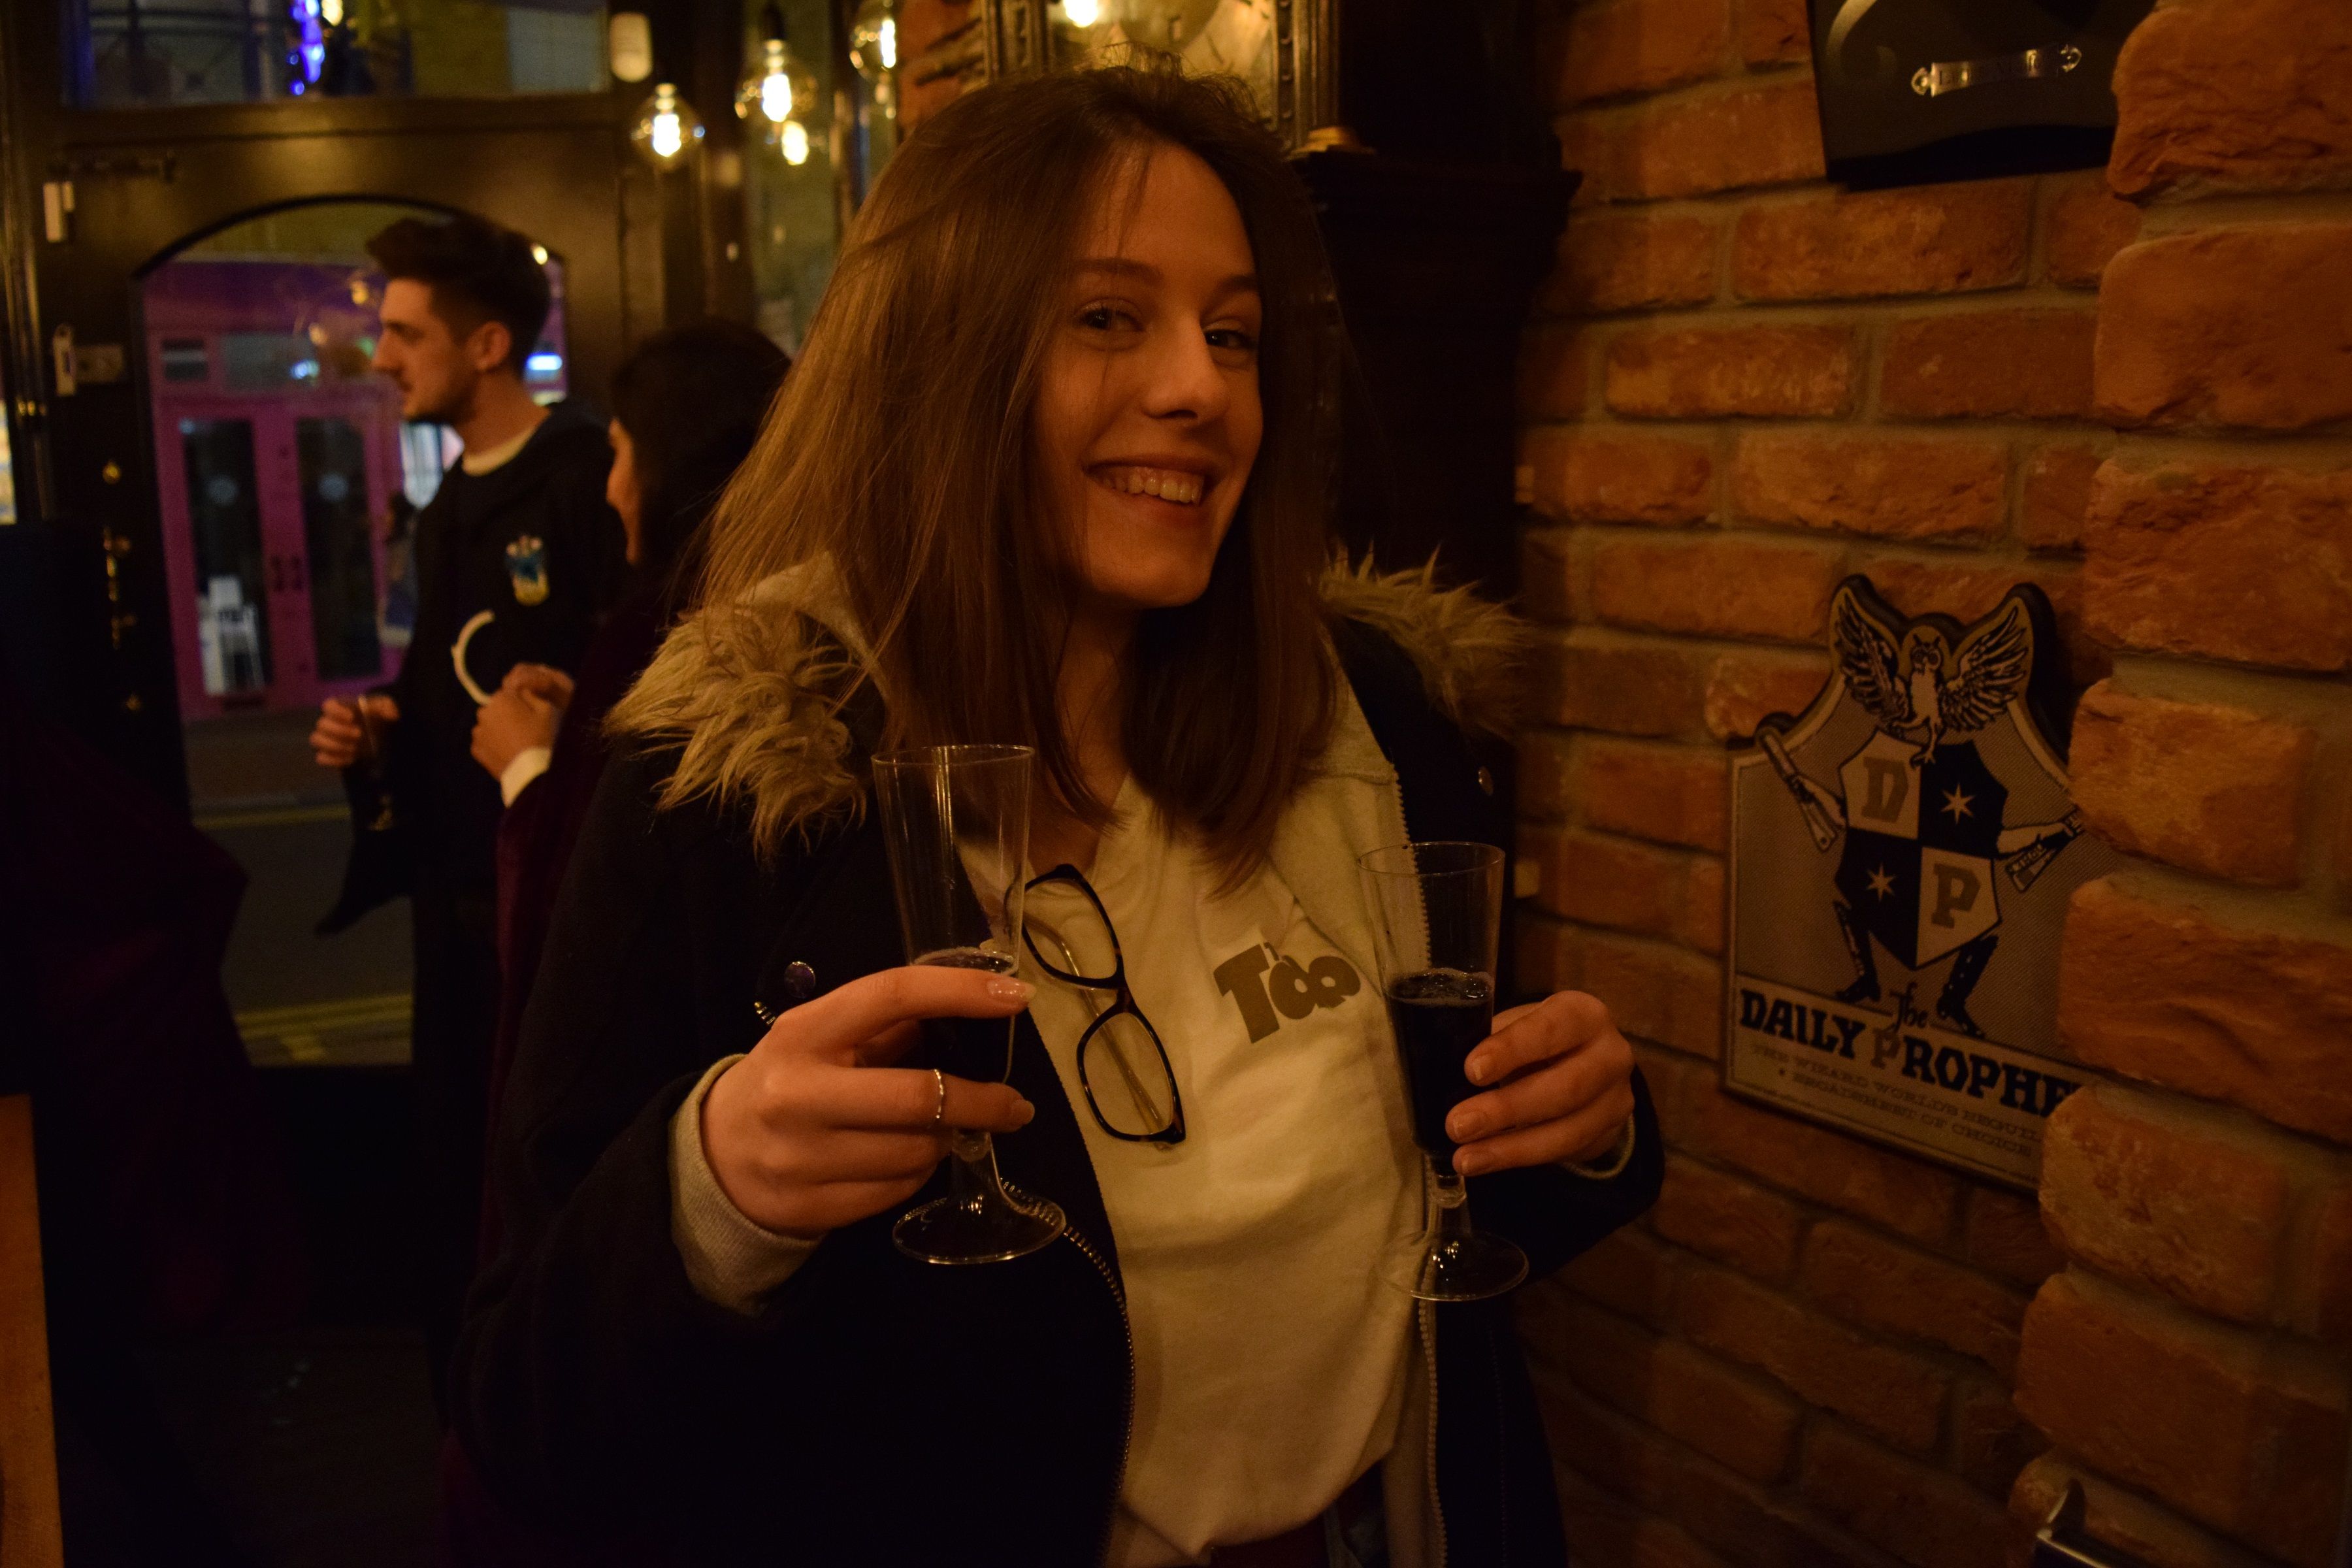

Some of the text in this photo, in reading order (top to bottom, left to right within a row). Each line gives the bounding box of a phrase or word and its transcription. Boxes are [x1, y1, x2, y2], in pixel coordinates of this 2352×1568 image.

[1862, 756, 1910, 823] D
[1931, 863, 1980, 929] P
[1740, 989, 1865, 1059] DAILY
[1889, 982, 1929, 1030] The
[1920, 1111, 1947, 1131] OF
